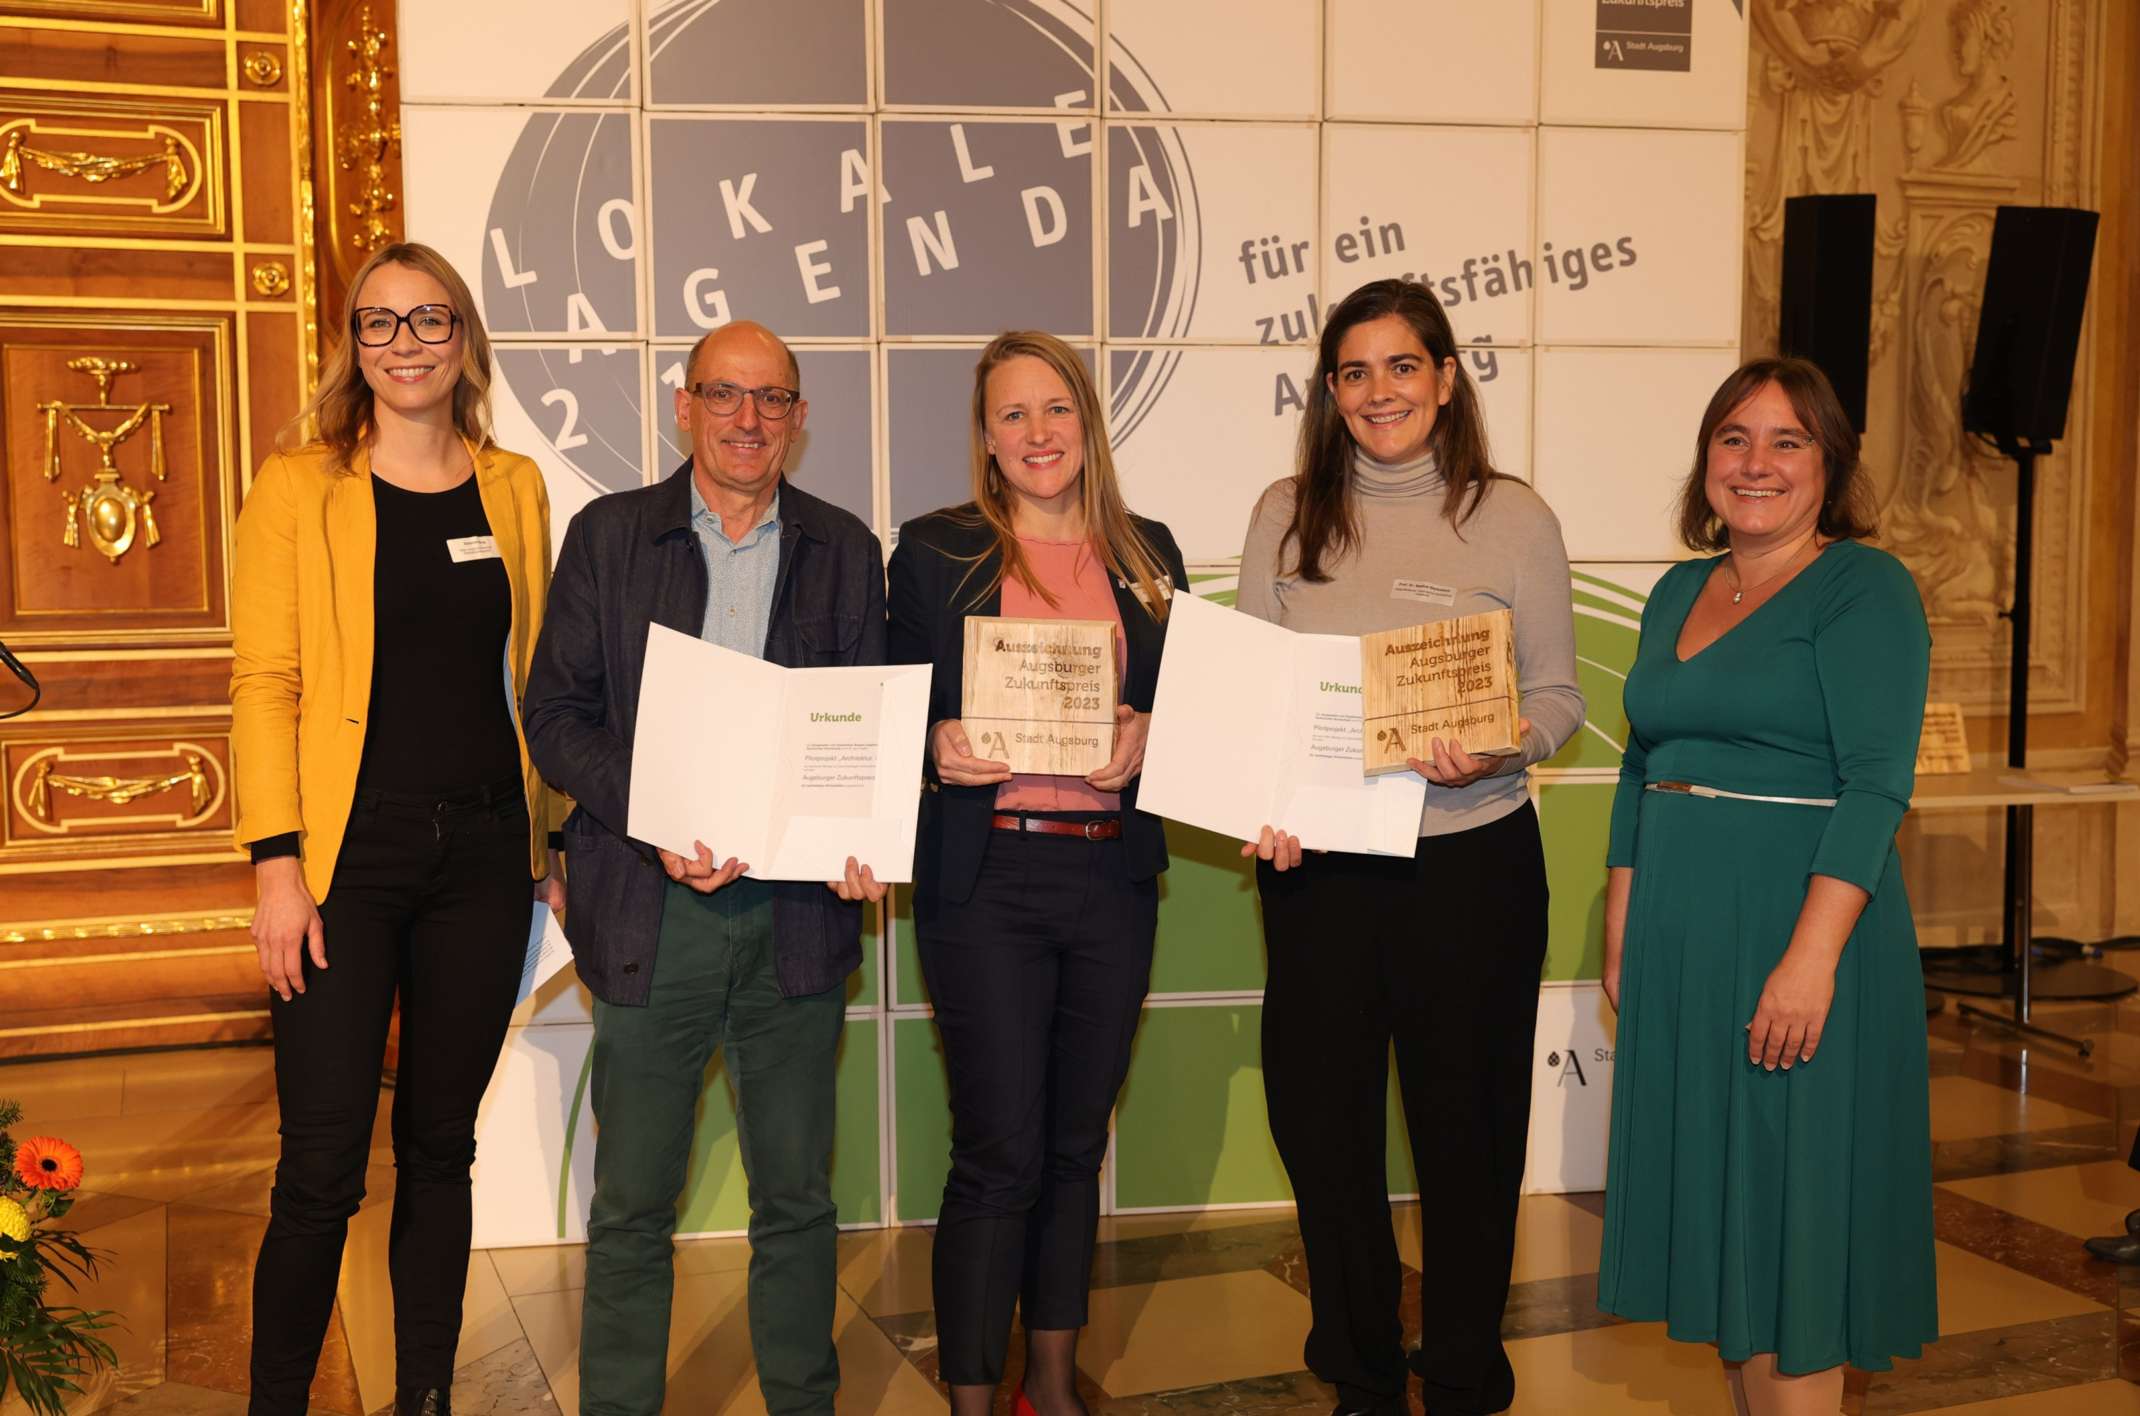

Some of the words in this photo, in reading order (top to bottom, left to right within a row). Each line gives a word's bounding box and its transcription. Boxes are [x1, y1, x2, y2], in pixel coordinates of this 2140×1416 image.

[490, 90, 1092, 288] LOKALE
[1238, 235, 1310, 284] für
[1335, 216, 1406, 263] ein
[566, 165, 1172, 364] AGENDA
[1384, 629, 1491, 657] Auszeichnung
[1409, 646, 1491, 669] Augsburger
[1019, 660, 1102, 677] Augsburger
[1396, 662, 1492, 687] Zukunftspreis
[1005, 676, 1101, 694] Zukunftspreis
[1320, 681, 1363, 694] Urkun
[1457, 676, 1494, 694] 2023
[1063, 696, 1101, 710] 2023
[810, 712, 862, 722] Urkunde
[1411, 722, 1440, 735] Stadt
[1441, 713, 1495, 730] Augsburg
[1015, 732, 1043, 744] Stadt
[1047, 734, 1099, 747] Augsburg
[1594, 1048, 1616, 1062] Sta
